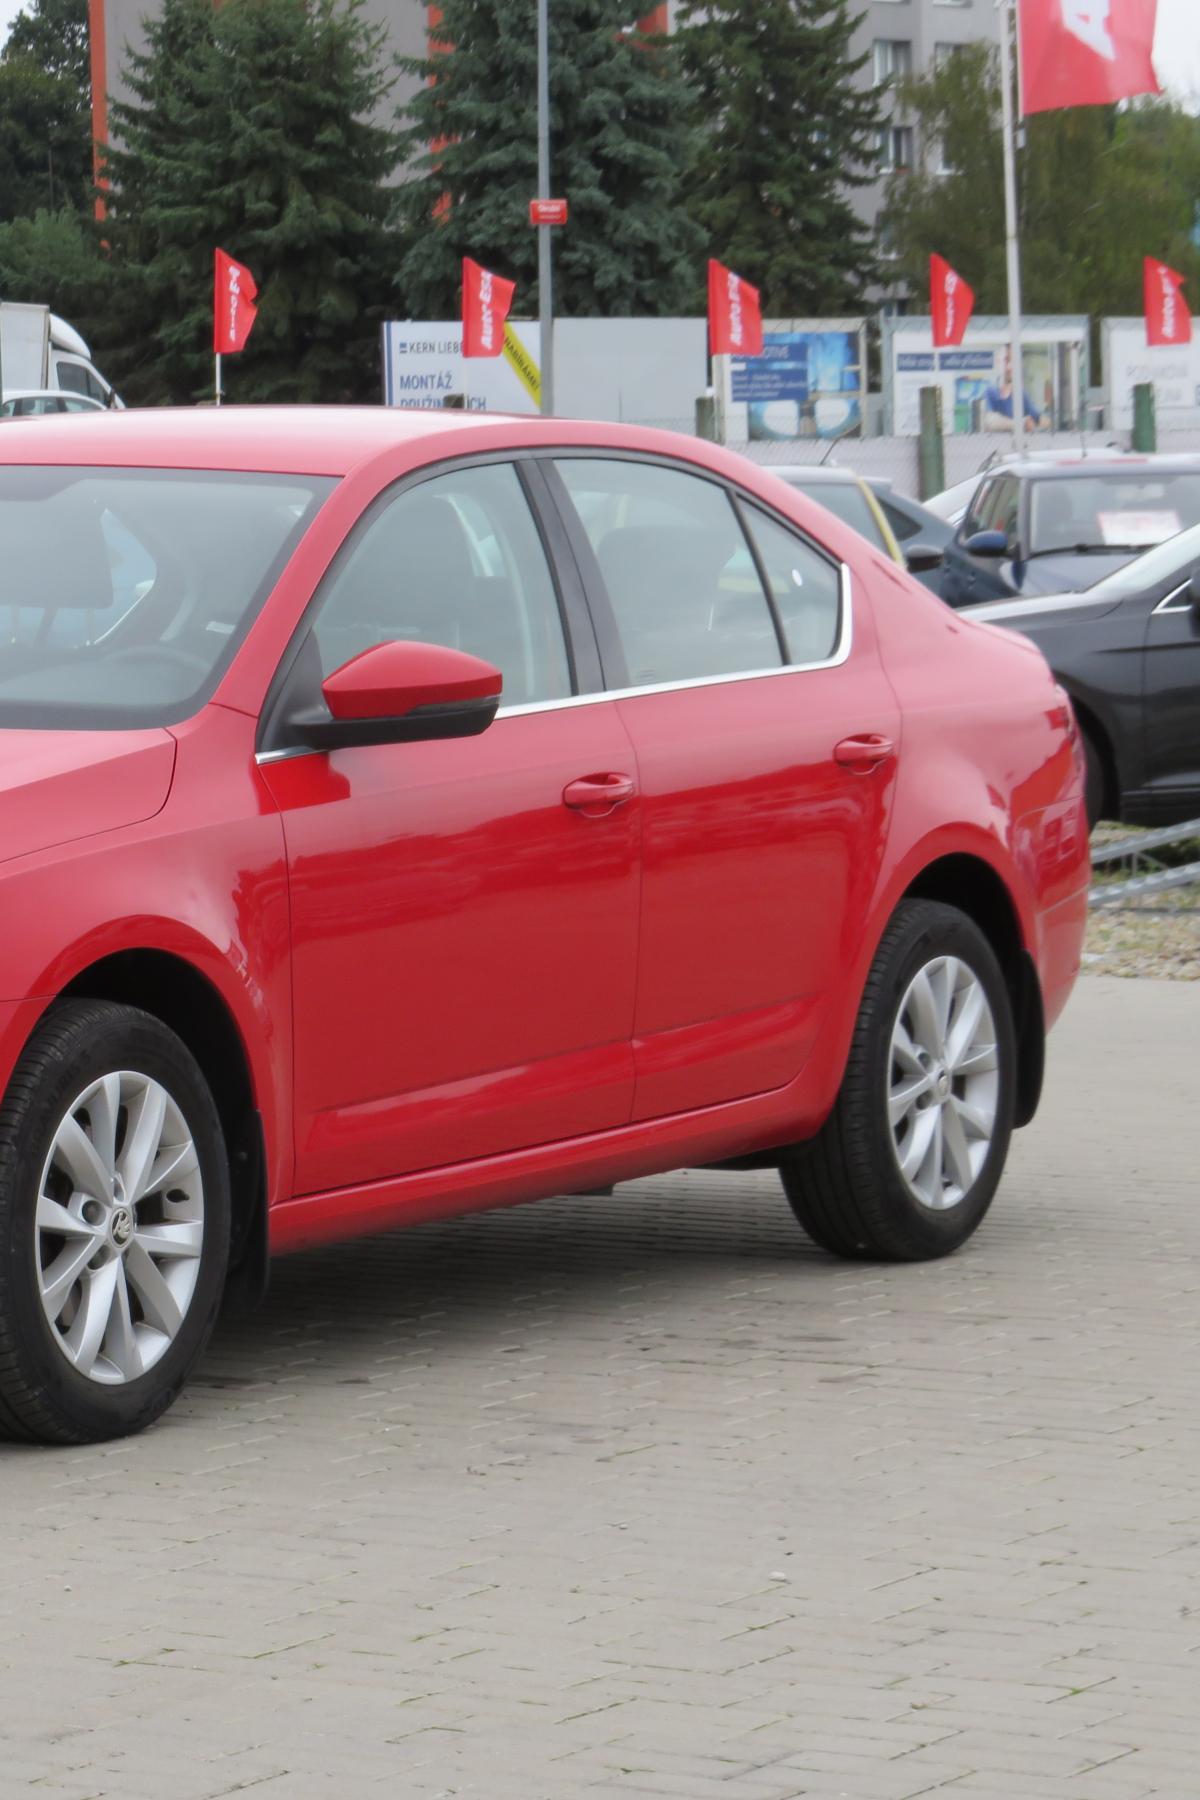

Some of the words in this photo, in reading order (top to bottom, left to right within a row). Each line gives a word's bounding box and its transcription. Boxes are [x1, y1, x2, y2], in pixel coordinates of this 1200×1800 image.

[409, 341, 435, 353] KERN
[438, 341, 464, 353] LIEB
[400, 371, 453, 389] MONTÁŽ
